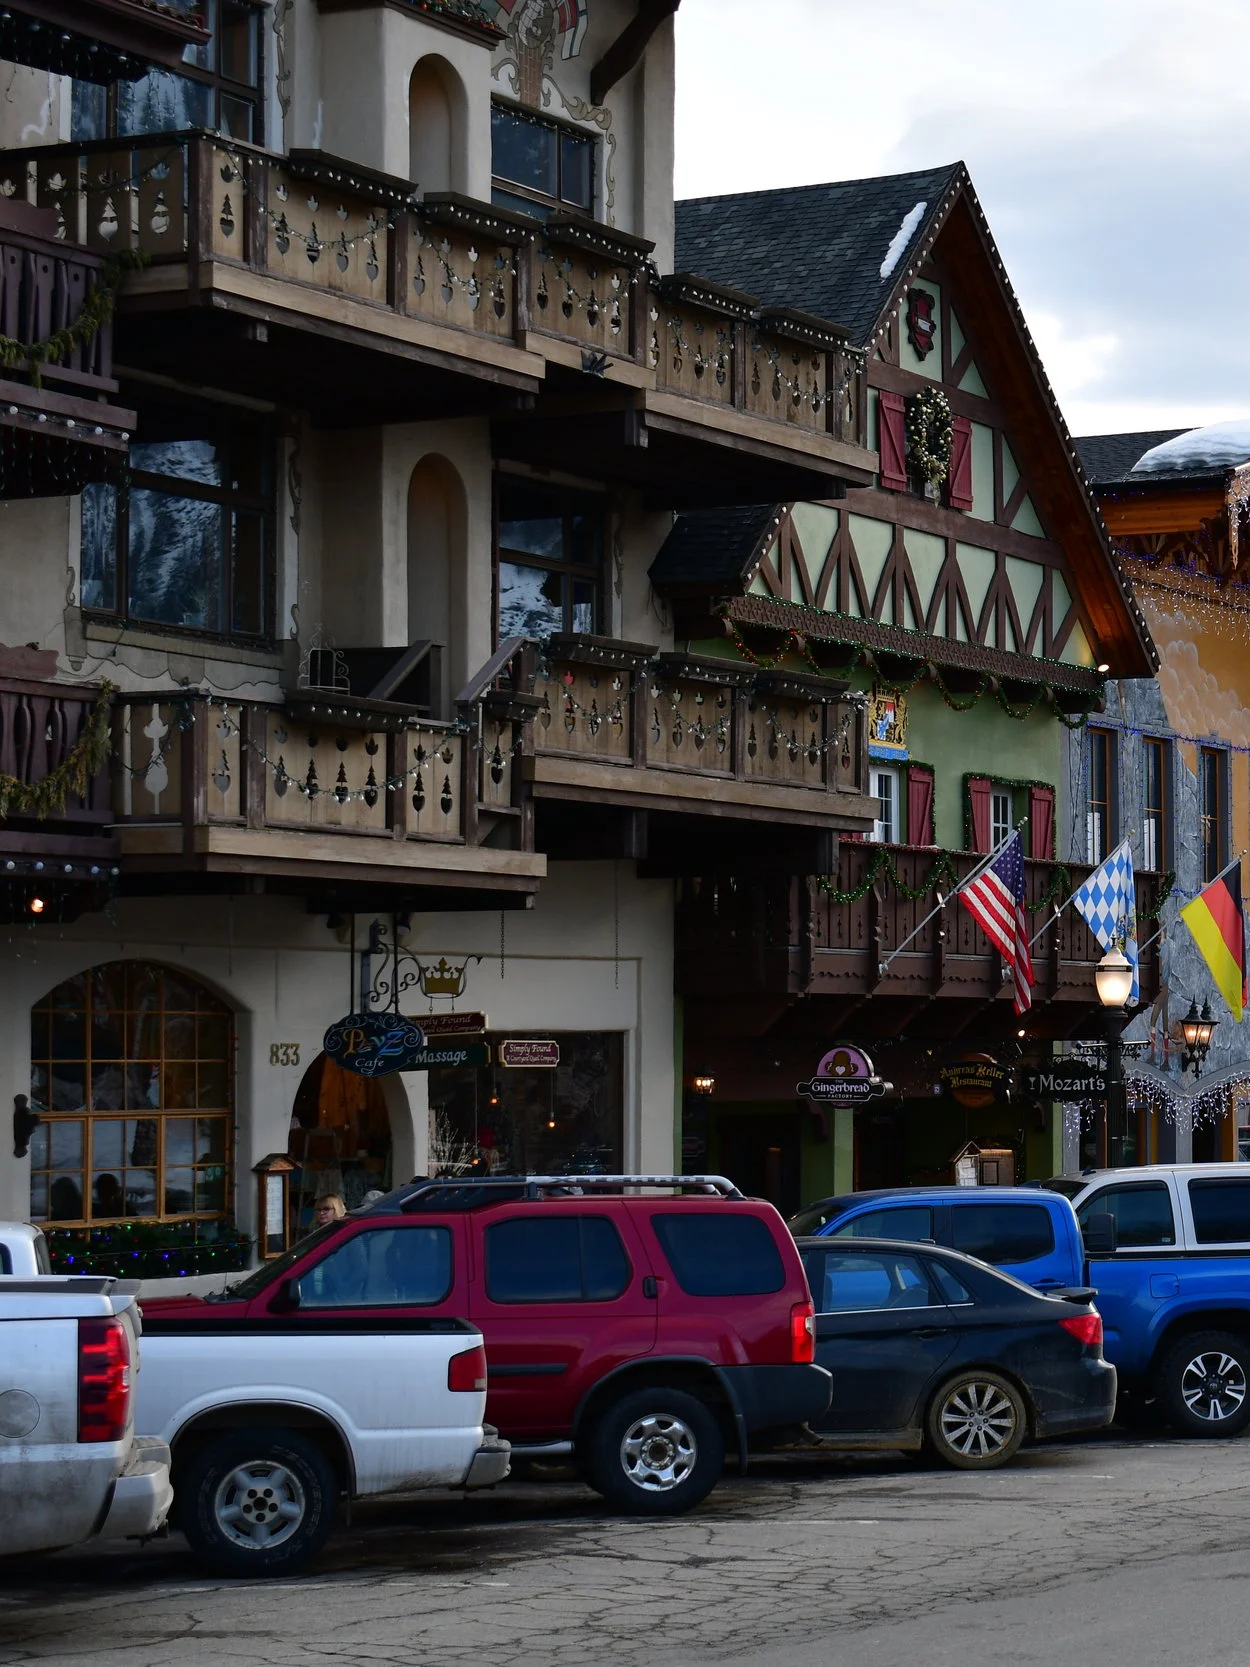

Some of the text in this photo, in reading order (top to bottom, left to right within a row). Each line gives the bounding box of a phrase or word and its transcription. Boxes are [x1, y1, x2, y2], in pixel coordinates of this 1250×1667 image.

[441, 1014, 472, 1026] Found
[270, 1043, 300, 1066] 833
[509, 1043, 552, 1056] Simply Found
[415, 1050, 469, 1066] Massage
[940, 1063, 1004, 1079] Andreas Keller
[812, 1082, 870, 1094] Gingerbread
[950, 1076, 993, 1088] Restaurant
[1039, 1074, 1105, 1094] Mozart's
